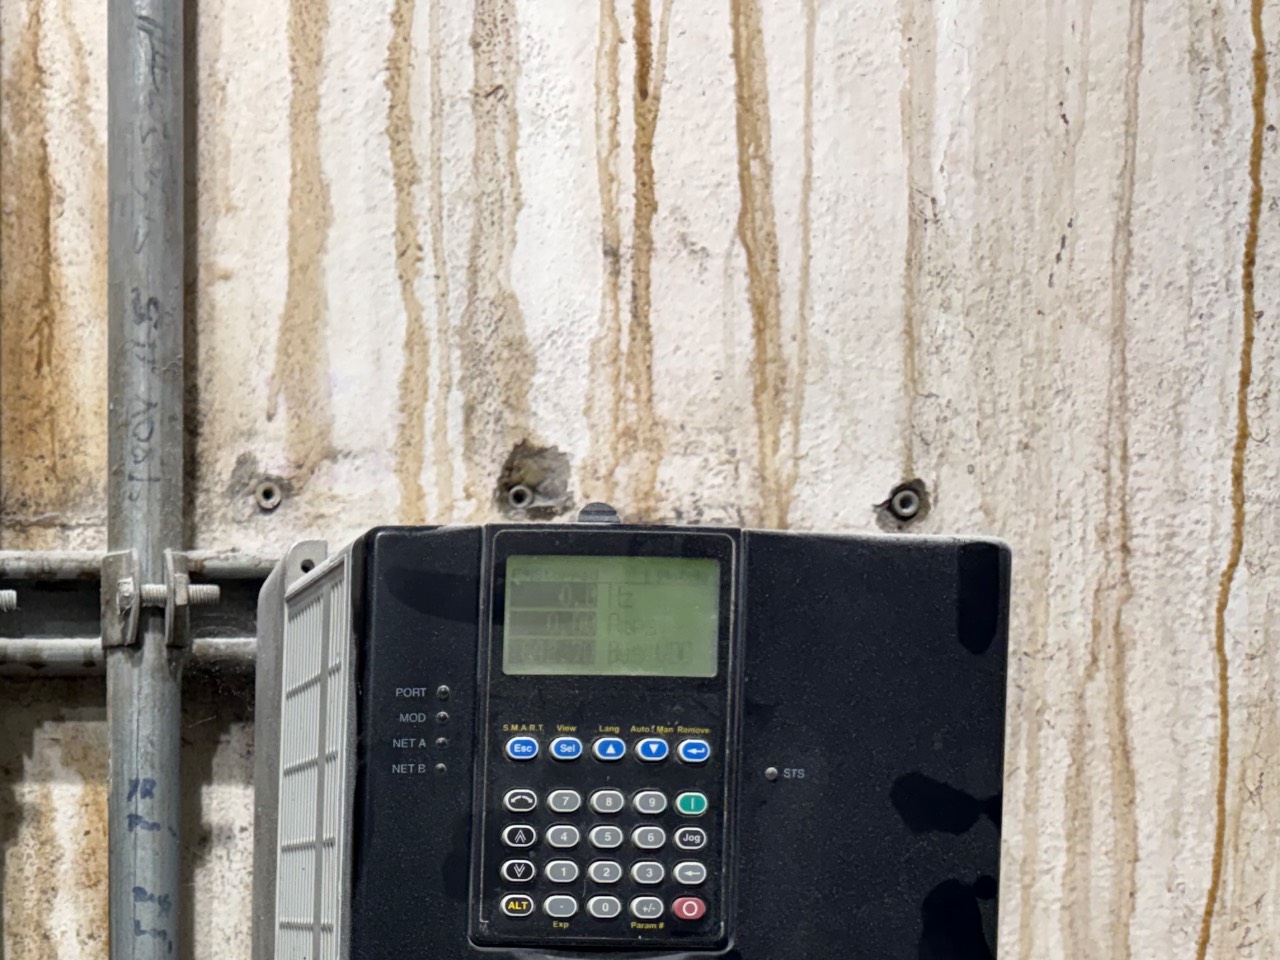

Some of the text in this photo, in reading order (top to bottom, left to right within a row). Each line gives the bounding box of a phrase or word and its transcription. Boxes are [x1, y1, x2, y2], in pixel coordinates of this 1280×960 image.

[395, 687, 426, 698] PORT
[399, 712, 426, 723] MOD
[556, 724, 577, 733] View
[599, 725, 620, 734] Lang
[630, 725, 650, 734] Auto
[656, 725, 674, 734] Man
[677, 726, 710, 735] Remove
[392, 738, 427, 749] NET A
[513, 743, 533, 753] Esc
[560, 743, 576, 753] Sel
[392, 763, 426, 775] NET B
[783, 767, 805, 779] STS
[683, 833, 701, 844] Jog
[507, 901, 529, 911] ALT
[552, 921, 570, 929] Exp
[630, 922, 657, 930] Param
